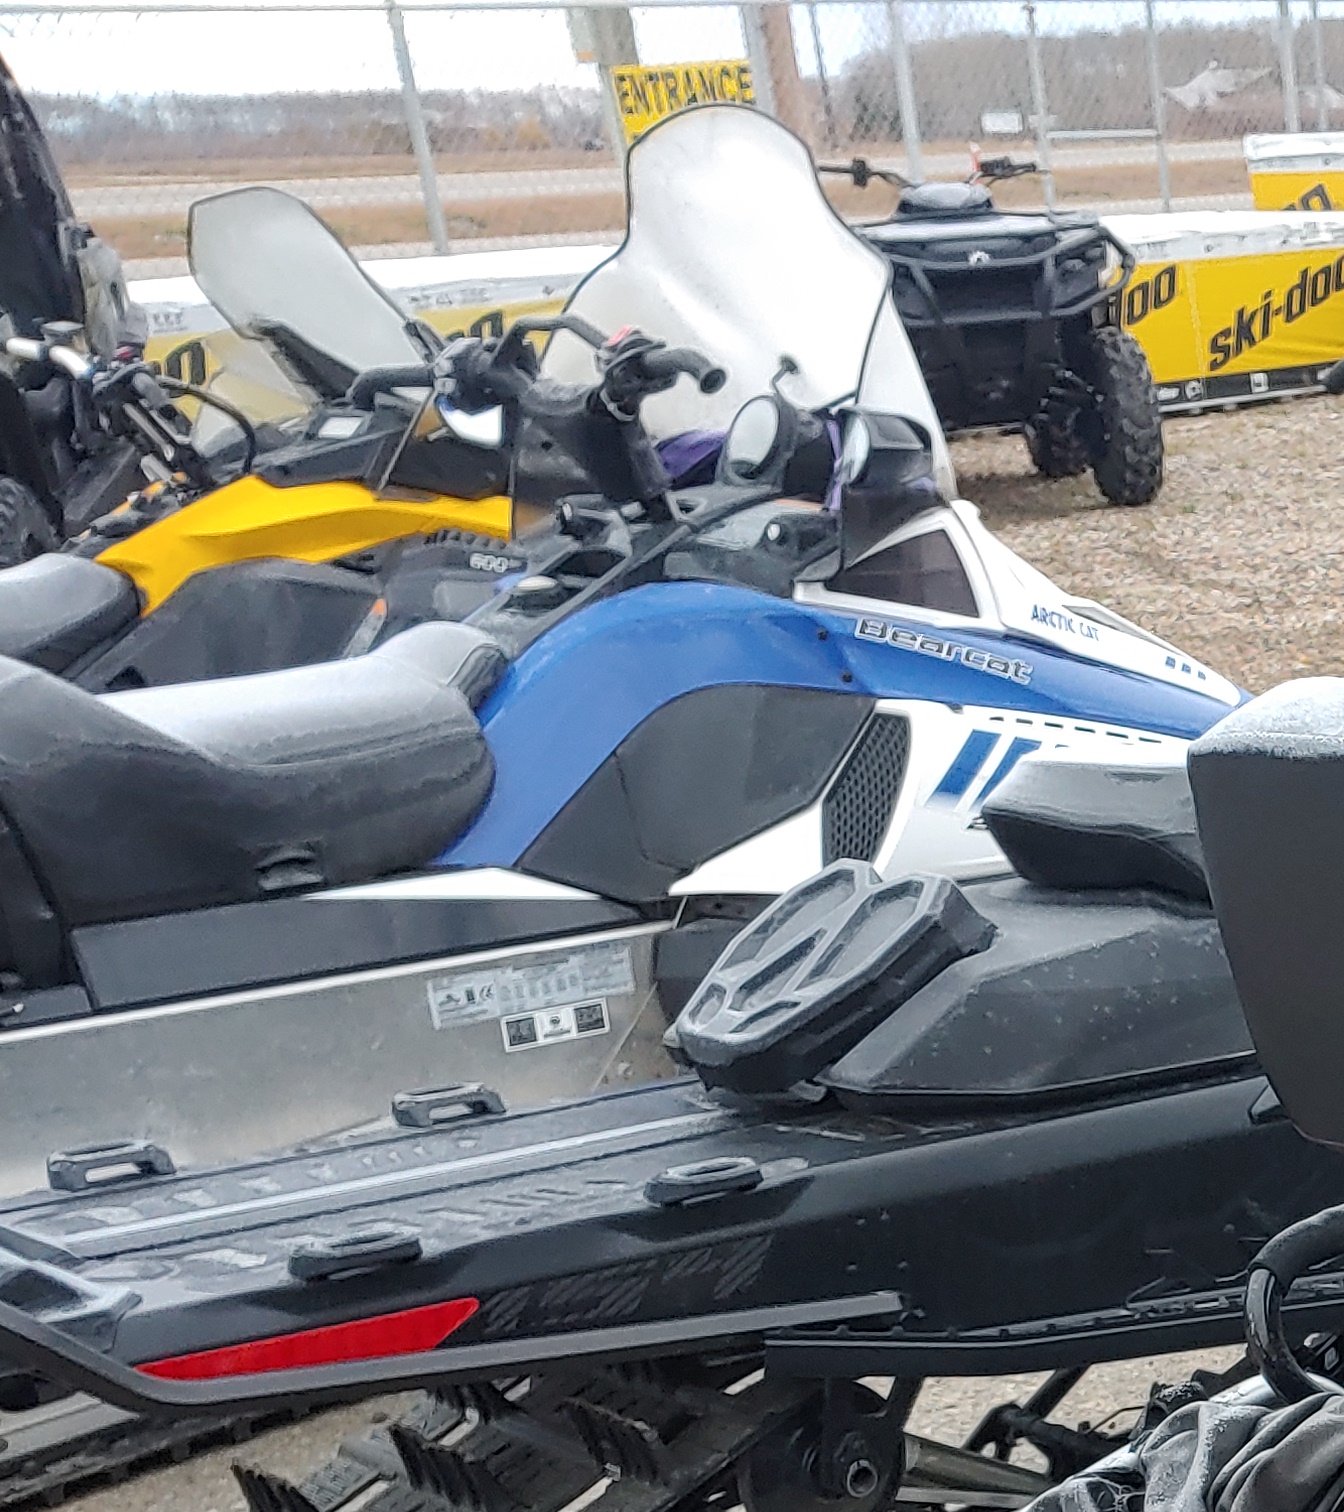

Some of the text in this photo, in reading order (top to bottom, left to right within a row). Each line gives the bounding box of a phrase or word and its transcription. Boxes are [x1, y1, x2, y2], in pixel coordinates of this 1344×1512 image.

[614, 66, 757, 116] ENTRANCE
[469, 552, 509, 573] 600
[1031, 603, 1100, 642] ARCTIC CAT
[854, 617, 1035, 686] Bearcat
